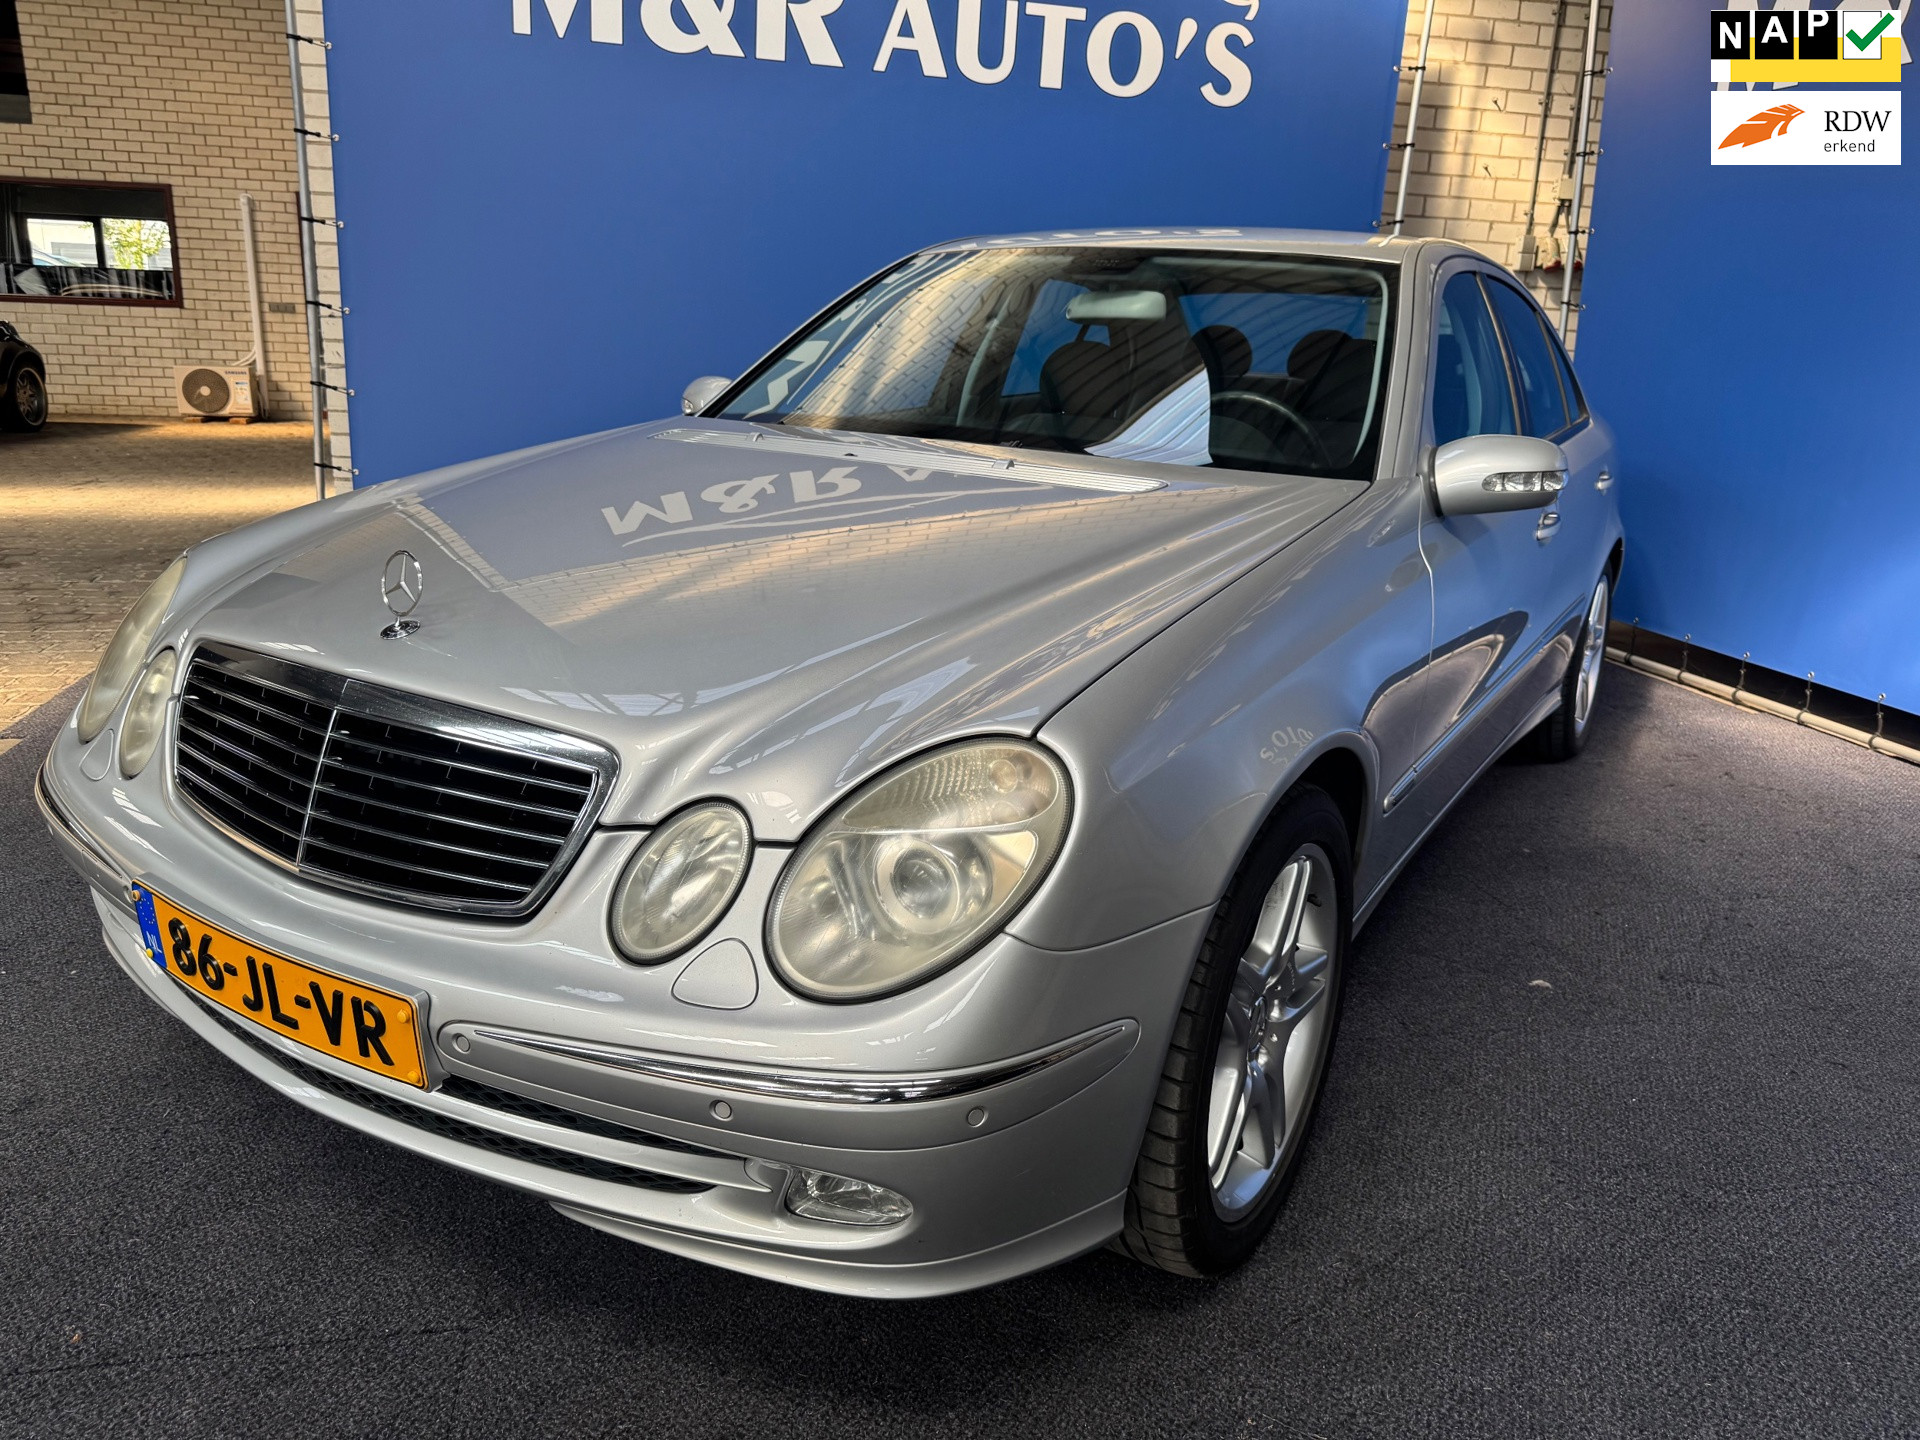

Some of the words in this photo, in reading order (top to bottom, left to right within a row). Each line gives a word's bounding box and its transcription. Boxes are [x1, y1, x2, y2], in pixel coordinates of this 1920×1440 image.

[872, 0, 1255, 108] AUTO'S
[145, 930, 163, 954] NL
[168, 917, 394, 1066] 86-JL-VR
